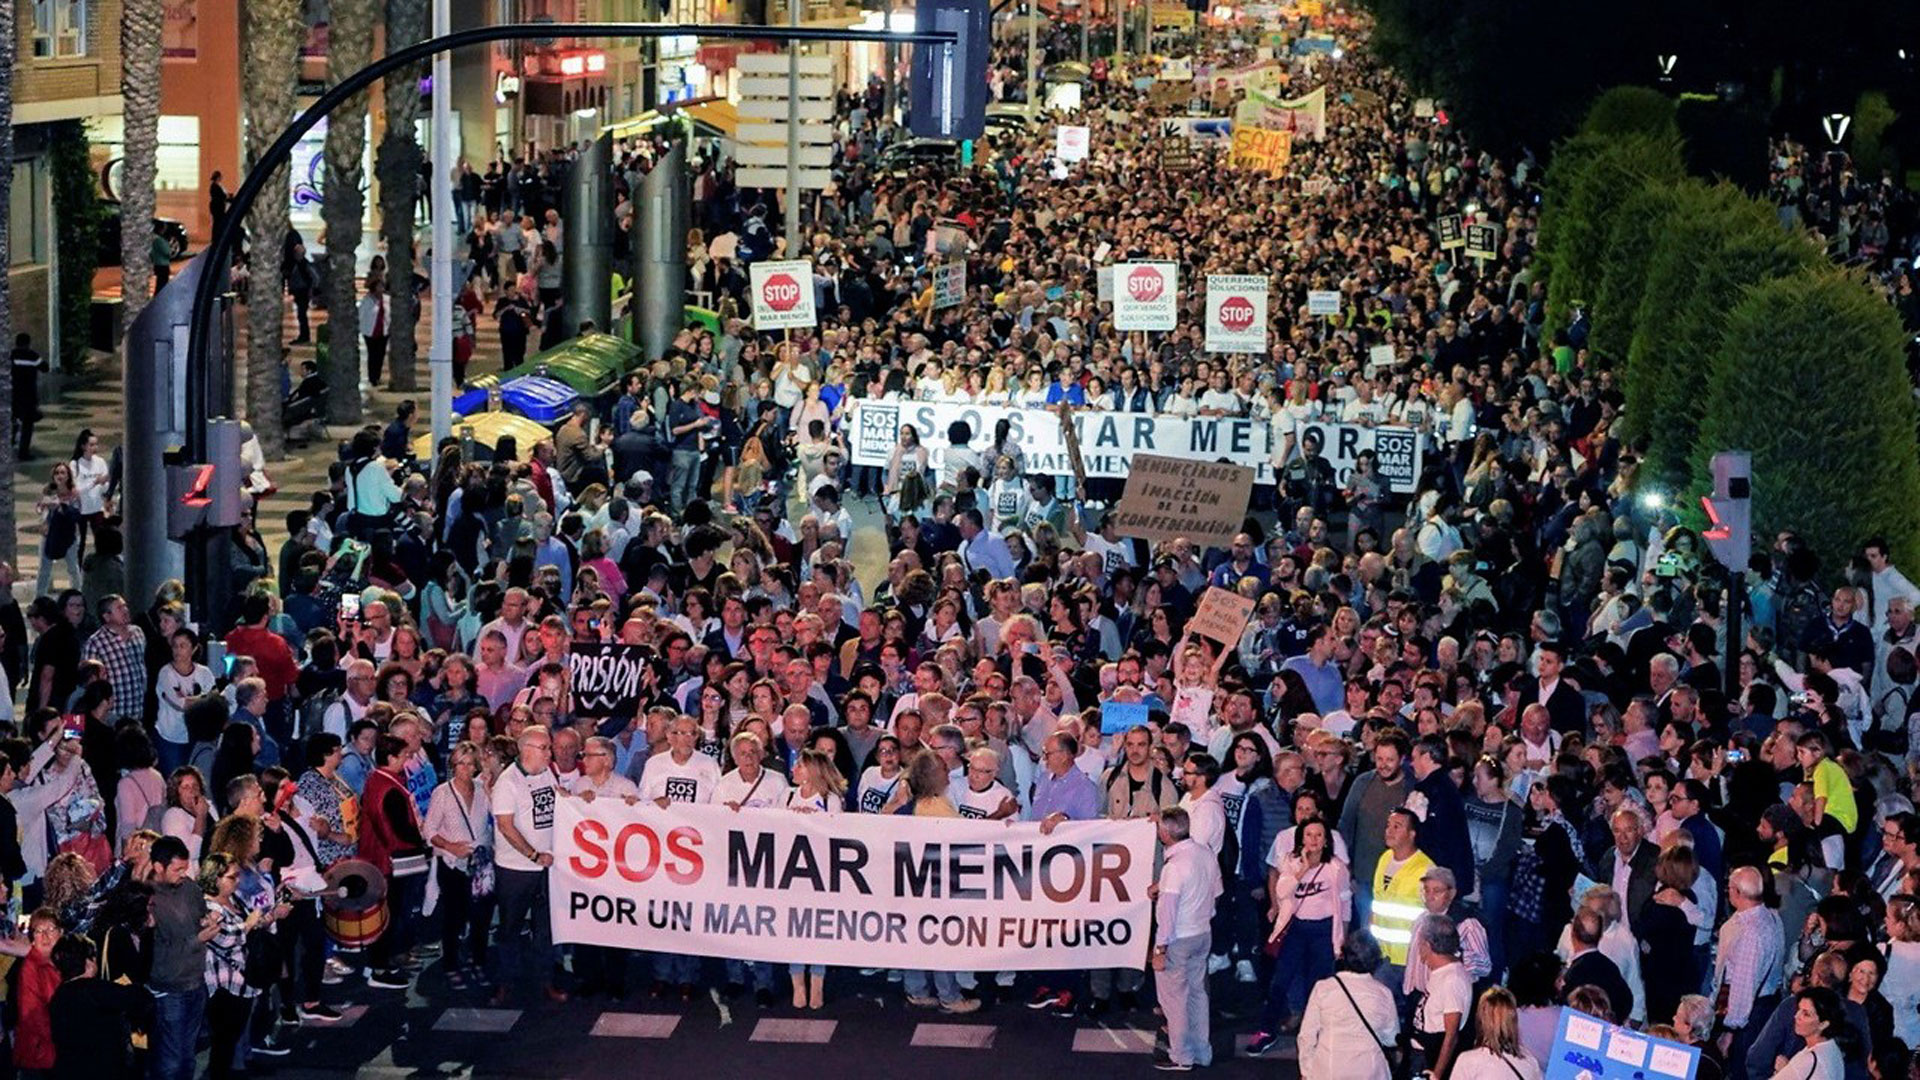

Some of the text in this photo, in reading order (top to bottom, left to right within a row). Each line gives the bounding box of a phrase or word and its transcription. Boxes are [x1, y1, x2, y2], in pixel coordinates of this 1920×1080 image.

[1129, 276, 1162, 292] STOP
[1209, 276, 1265, 284] QUEREMOS
[764, 284, 798, 302] STOP
[1209, 284, 1266, 292] SOLUCIONES
[1220, 306, 1254, 322] STOP
[863, 411, 897, 427] SOS
[863, 427, 895, 440] MAR
[1377, 436, 1412, 454] SOS
[1377, 453, 1410, 465] MAR
[1181, 478, 1195, 488] LA
[1158, 501, 1198, 514] DE LA
[570, 646, 645, 698] PRISIÓN
[667, 782, 695, 796] SOS
[534, 792, 553, 806] SOS
[569, 819, 1132, 903] SOS MAR MENOR
[569, 891, 1132, 949] POR UN MAR MENOR CON FUTURO
